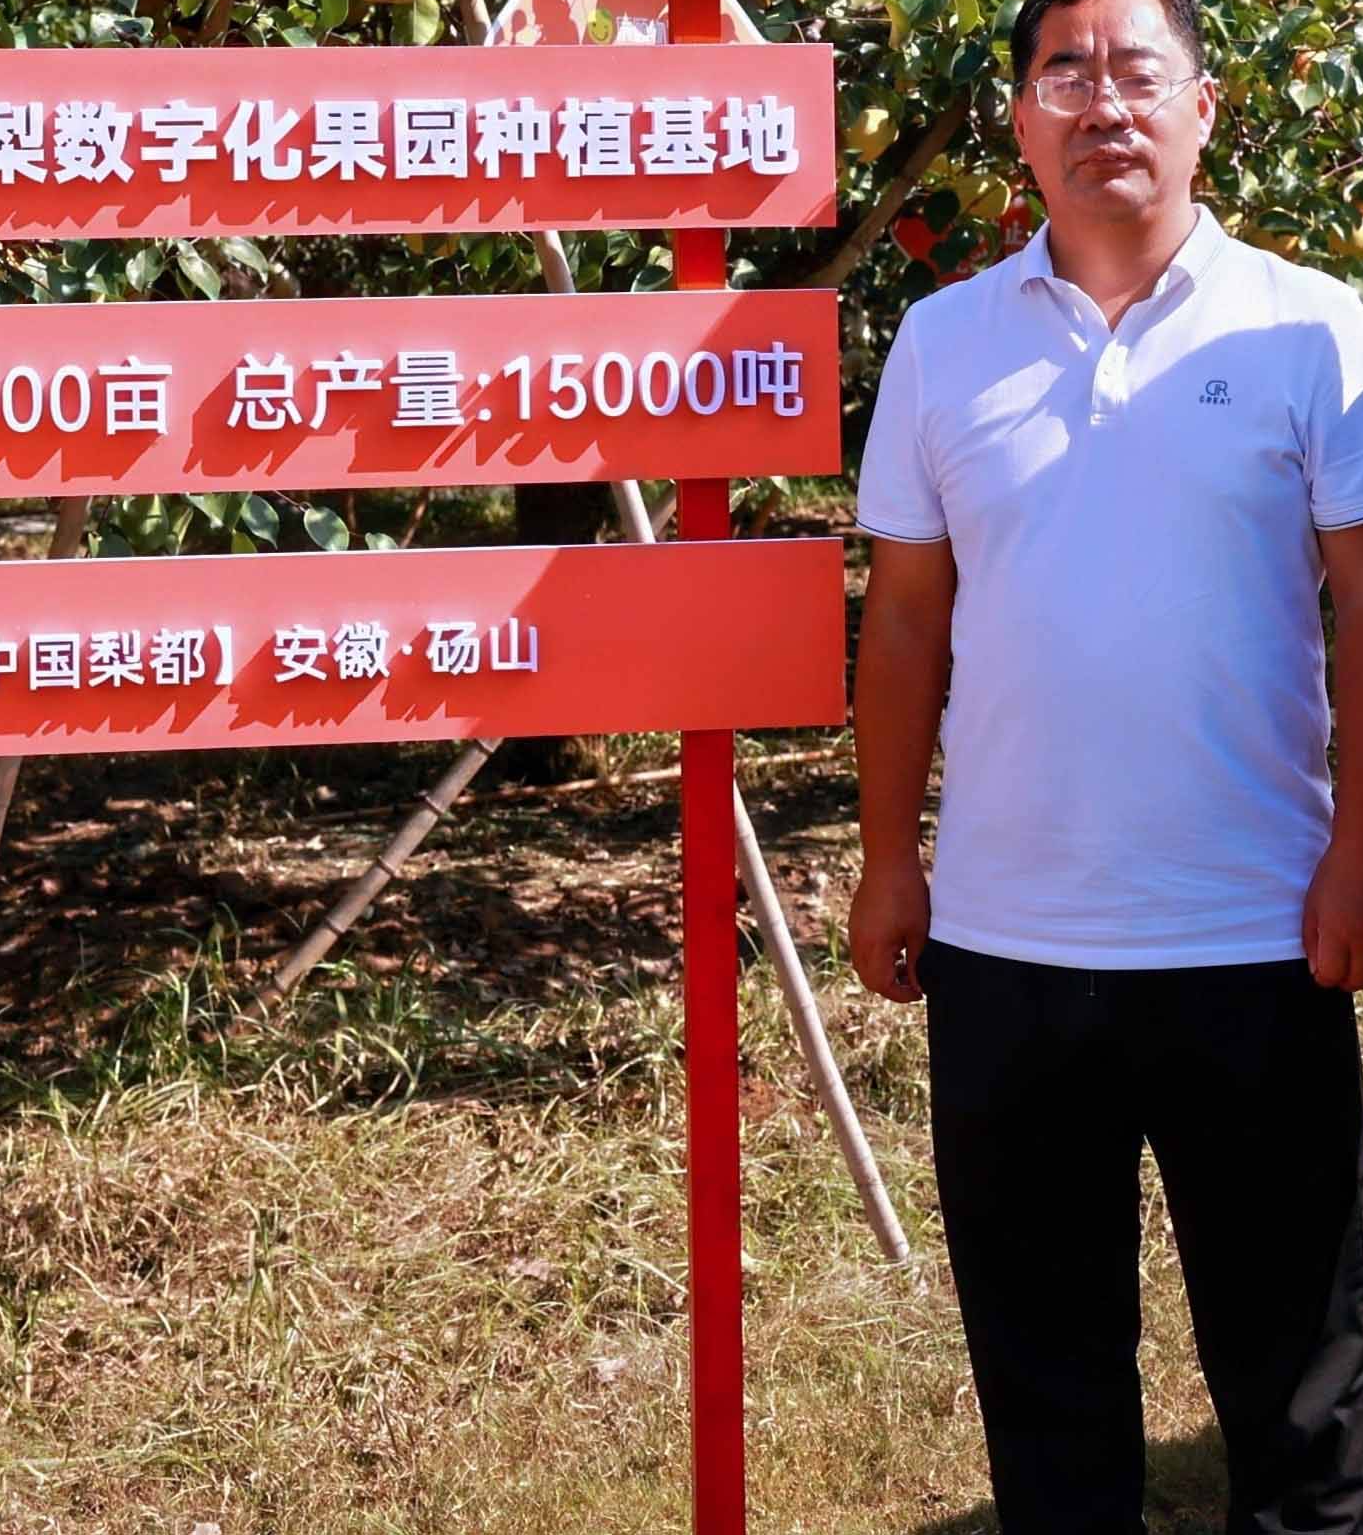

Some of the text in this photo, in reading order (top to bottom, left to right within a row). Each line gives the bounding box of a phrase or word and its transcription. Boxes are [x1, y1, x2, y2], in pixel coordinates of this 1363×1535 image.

[227, 339, 804, 430] 总产量:15000吨
[273, 614, 540, 683] 安徽·砀山
